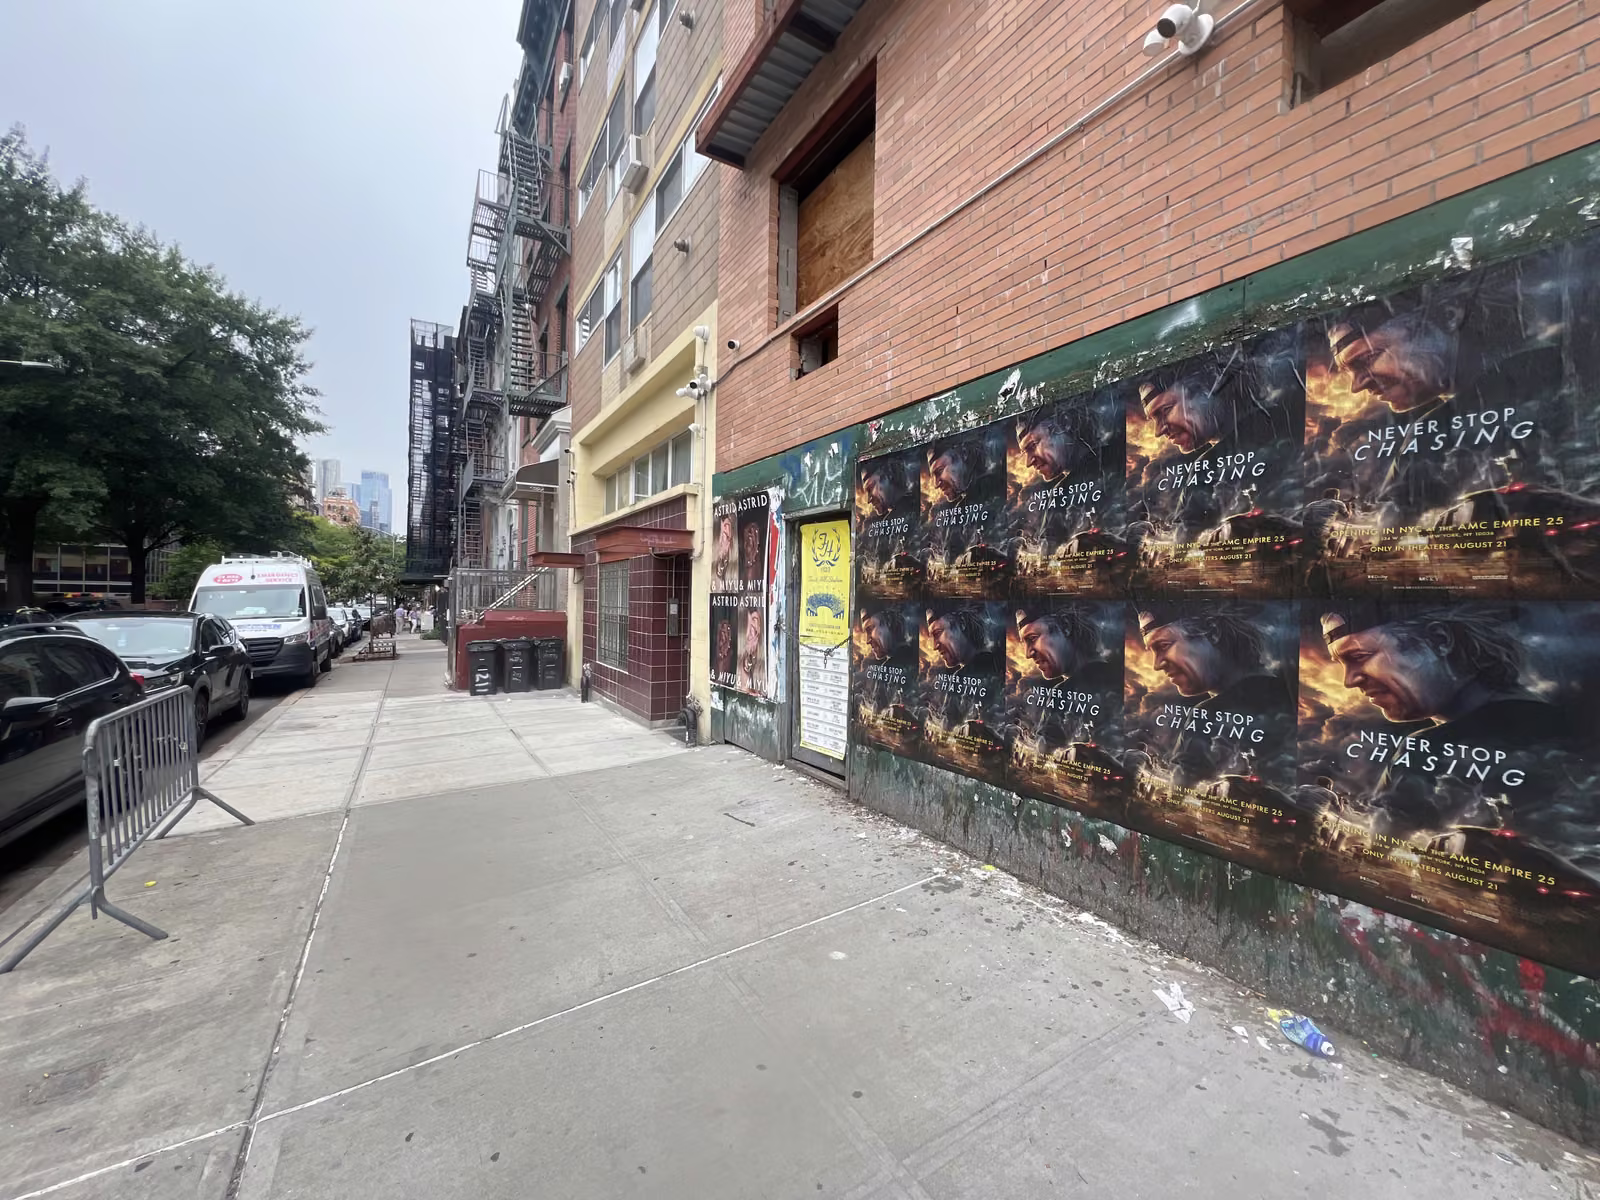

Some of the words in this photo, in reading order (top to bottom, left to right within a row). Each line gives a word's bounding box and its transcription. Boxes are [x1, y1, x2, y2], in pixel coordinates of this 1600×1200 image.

[1368, 420, 1439, 443] NEVER
[1451, 407, 1516, 430] STOP
[1354, 421, 1534, 461] CHASING
[1166, 459, 1210, 477] NEVER
[1216, 451, 1255, 468] STOP
[1157, 462, 1267, 491] CHASING
[1034, 487, 1064, 501] NEVER
[1068, 481, 1094, 494] STOP
[714, 502, 737, 517] ASTRID
[738, 494, 768, 512] ASTRID
[1028, 490, 1102, 512] CHASING
[936, 511, 989, 527] CHASING
[940, 507, 962, 518] NEVER
[964, 503, 983, 514] STOP
[868, 523, 909, 537] CHASING
[871, 519, 889, 529] NEVER
[890, 517, 905, 527] STOP
[1330, 528, 1378, 538] OPENING
[1382, 527, 1395, 535] IN
[1399, 525, 1423, 534] NYC
[1457, 521, 1489, 531] AMC
[1493, 518, 1540, 529] EMPIRE
[1546, 516, 1564, 526] 25
[1222, 538, 1240, 546] AMC
[1242, 536, 1271, 545] EMPIRE
[1274, 535, 1285, 543] 25
[1370, 545, 1392, 553] ONLY
[1408, 543, 1450, 551] THEATERS
[1453, 541, 1493, 550] AUGUST
[1496, 540, 1507, 548] 21
[719, 580, 738, 591] MIYU
[712, 595, 738, 607] ASTRID
[718, 671, 736, 685] MIYU
[866, 671, 906, 685] CHASING
[869, 664, 887, 673] NEVER
[889, 667, 902, 675] STOP
[746, 678, 767, 692] MIYU
[938, 673, 960, 684] NEVER
[963, 676, 982, 686] STOP
[934, 681, 987, 697] CHASING
[1032, 686, 1063, 698] NEVER
[1067, 691, 1093, 703] STOP
[1026, 694, 1100, 716] CHASING
[1164, 703, 1208, 720] NEVER
[1215, 711, 1254, 726] STOP
[1155, 714, 1265, 743] CHASING
[1360, 730, 1431, 754] NEVER
[1443, 743, 1507, 764] STOP
[1082, 763, 1102, 773] EMPIRE
[1346, 743, 1526, 786] CHASING
[1219, 796, 1239, 808] AMC
[1240, 801, 1269, 814] EMPIRE
[1271, 808, 1283, 817] 25
[1217, 811, 1241, 821] AUGUST
[1323, 820, 1370, 838] OPENING
[1375, 833, 1387, 843] IN
[1391, 837, 1415, 849] NYC
[1431, 848, 1446, 858] THE
[1449, 852, 1480, 866] AMC
[1484, 860, 1533, 880] EMPIRE
[1537, 874, 1557, 886] 25
[1362, 848, 1385, 859] ONLY
[1387, 855, 1397, 863] IN
[1400, 858, 1442, 875] THEATERS
[1444, 871, 1485, 887] AUGUST
[1487, 882, 1499, 891] 21
